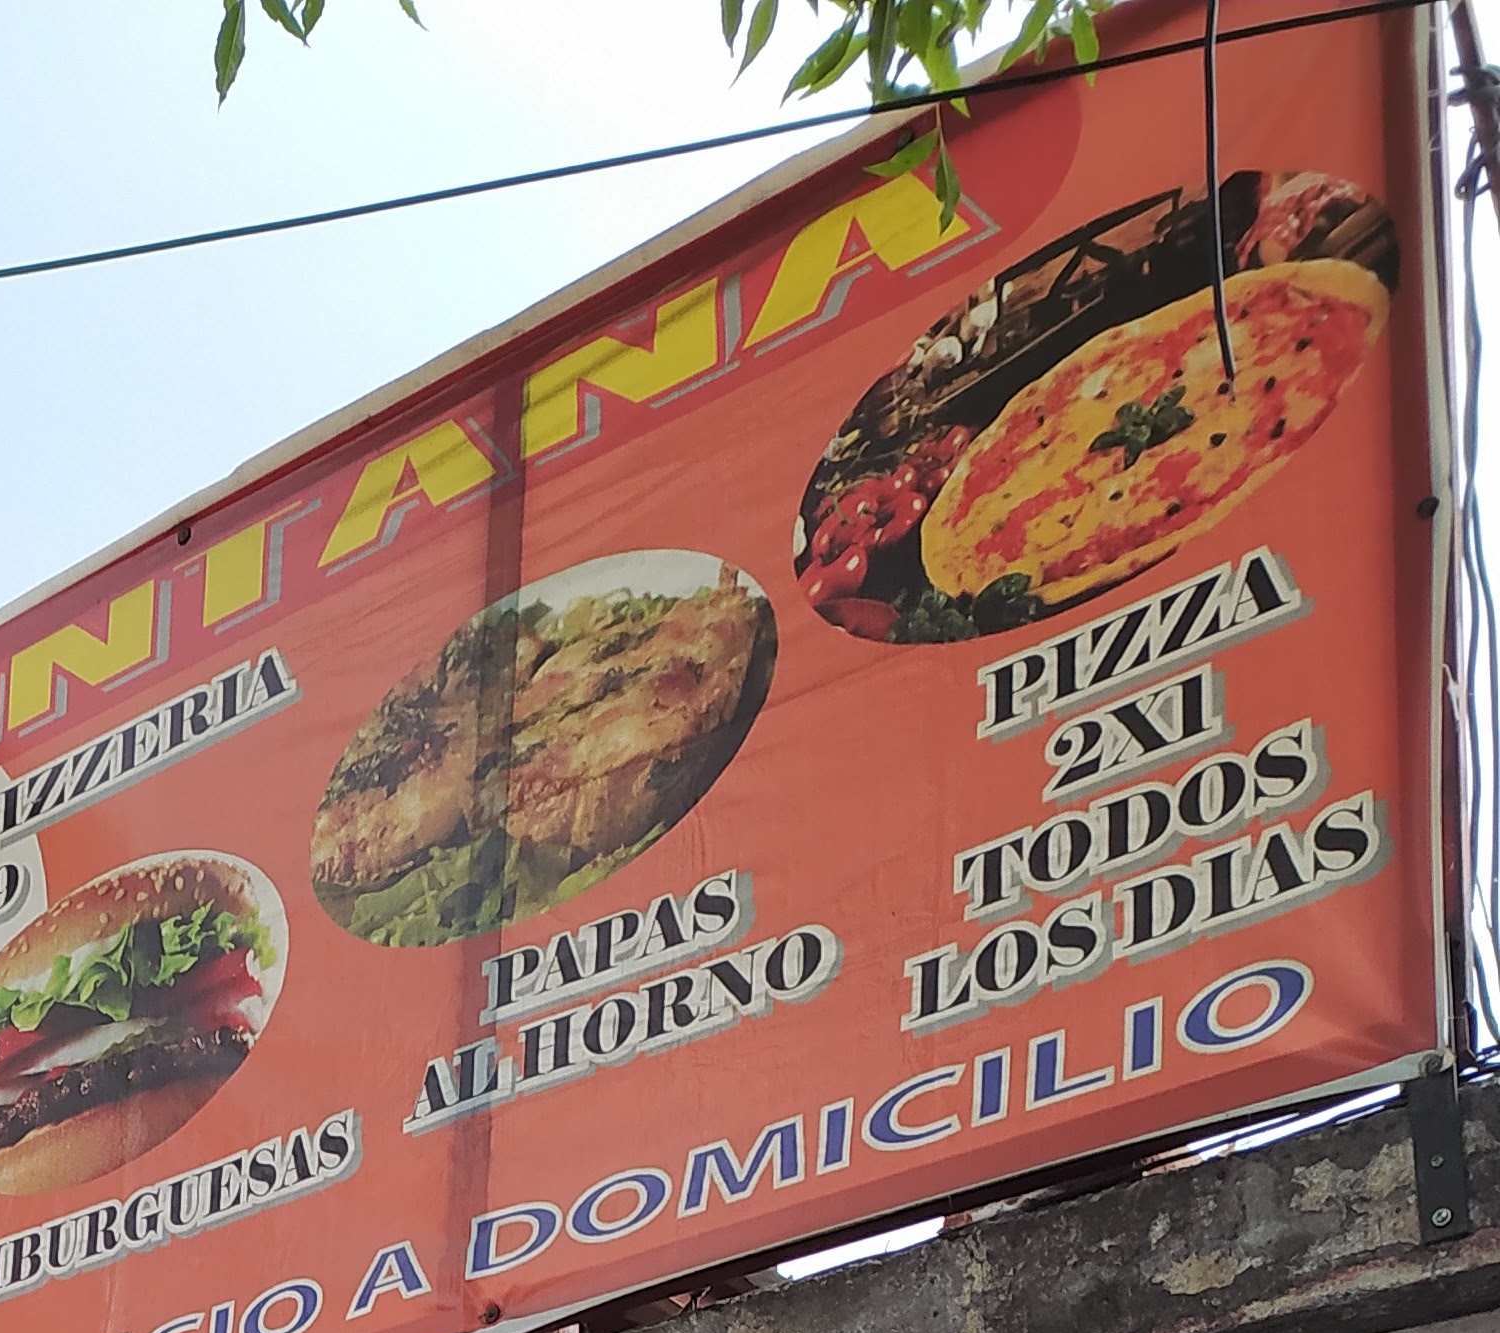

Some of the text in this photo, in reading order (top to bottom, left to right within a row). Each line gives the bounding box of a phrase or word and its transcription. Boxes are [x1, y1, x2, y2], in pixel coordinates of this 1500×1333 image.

[980, 548, 1294, 732] PIZZA
[905, 797, 1377, 1028] LOS DIAS
[957, 722, 1315, 917] TODOS
[408, 927, 831, 1126] AL HORNO
[488, 871, 742, 1017] PAPAS
[346, 1240, 433, 1319] A
[465, 960, 1315, 1280] DOMICILIO
